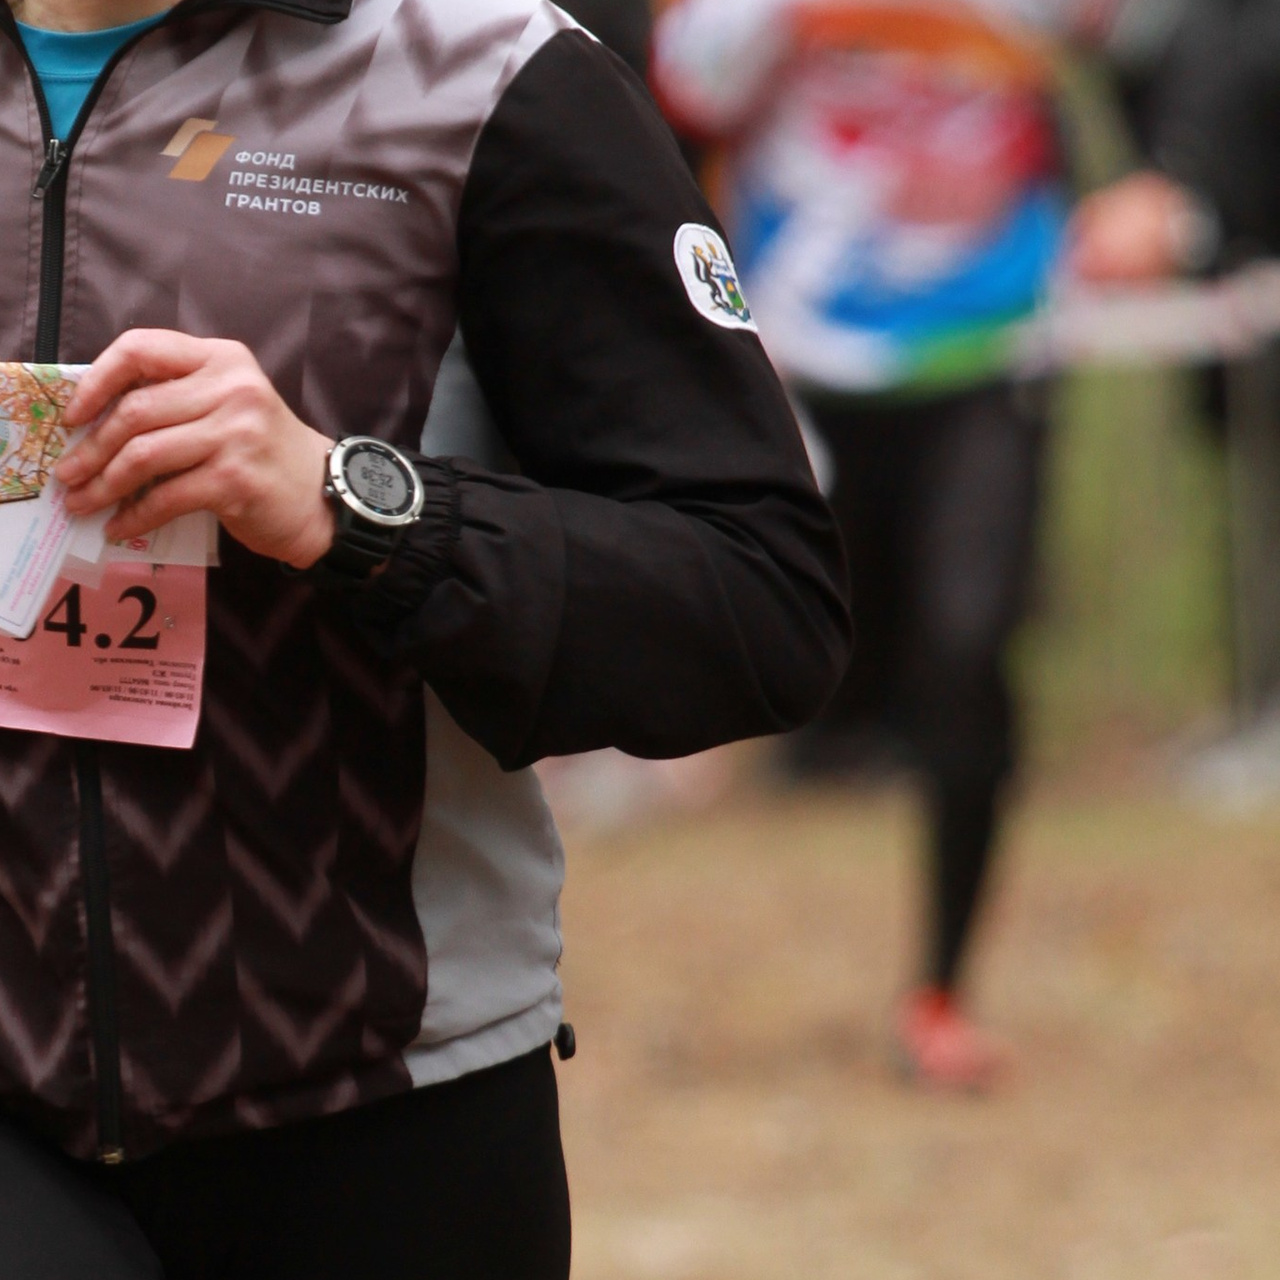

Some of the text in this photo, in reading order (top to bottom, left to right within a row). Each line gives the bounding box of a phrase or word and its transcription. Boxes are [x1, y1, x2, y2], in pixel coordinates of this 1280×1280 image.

[234, 150, 296, 170] ФОНД
[228, 170, 410, 204] ПРЕЗИДЕНТСКИХ
[224, 192, 322, 216] ГРАНТОВ
